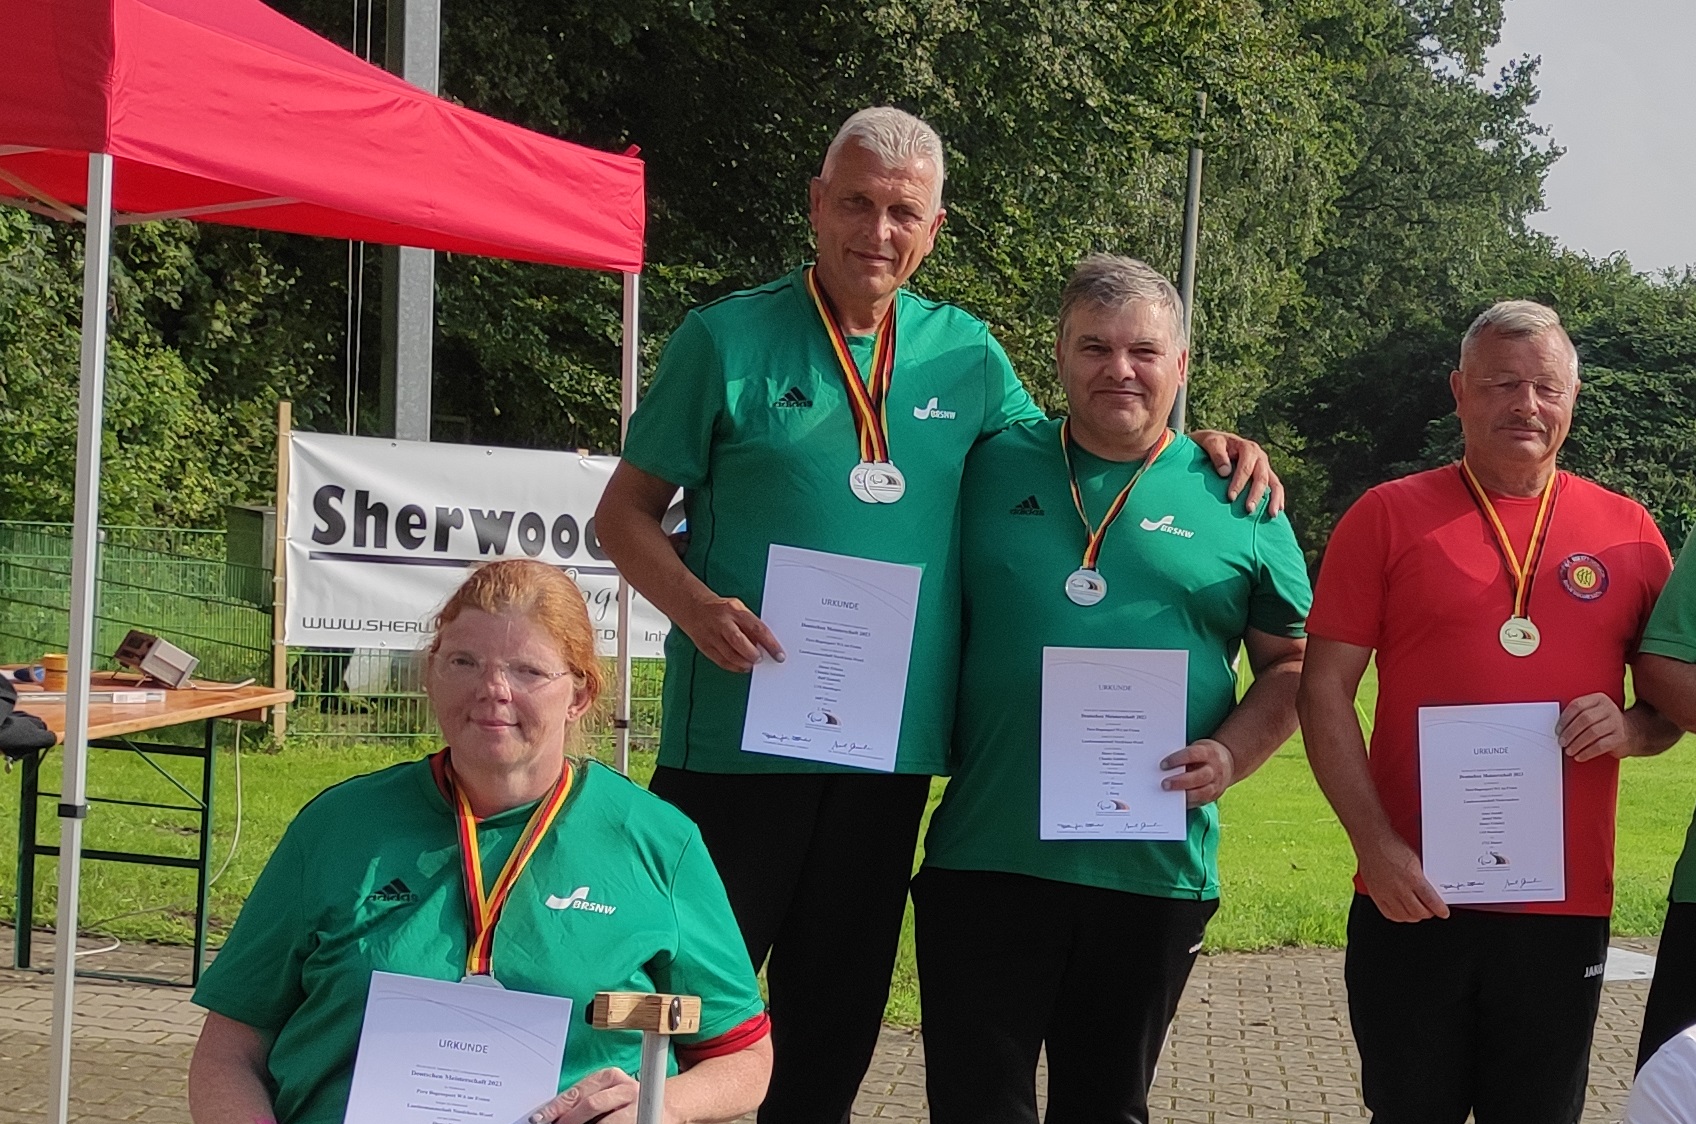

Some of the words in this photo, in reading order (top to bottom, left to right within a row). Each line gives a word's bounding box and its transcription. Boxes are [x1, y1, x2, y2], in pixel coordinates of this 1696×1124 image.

[821, 598, 859, 610] URKUNDE
[1474, 747, 1509, 755] URKUNDE
[572, 900, 617, 915] BRSNW
[439, 1039, 488, 1054] URKUNDE
